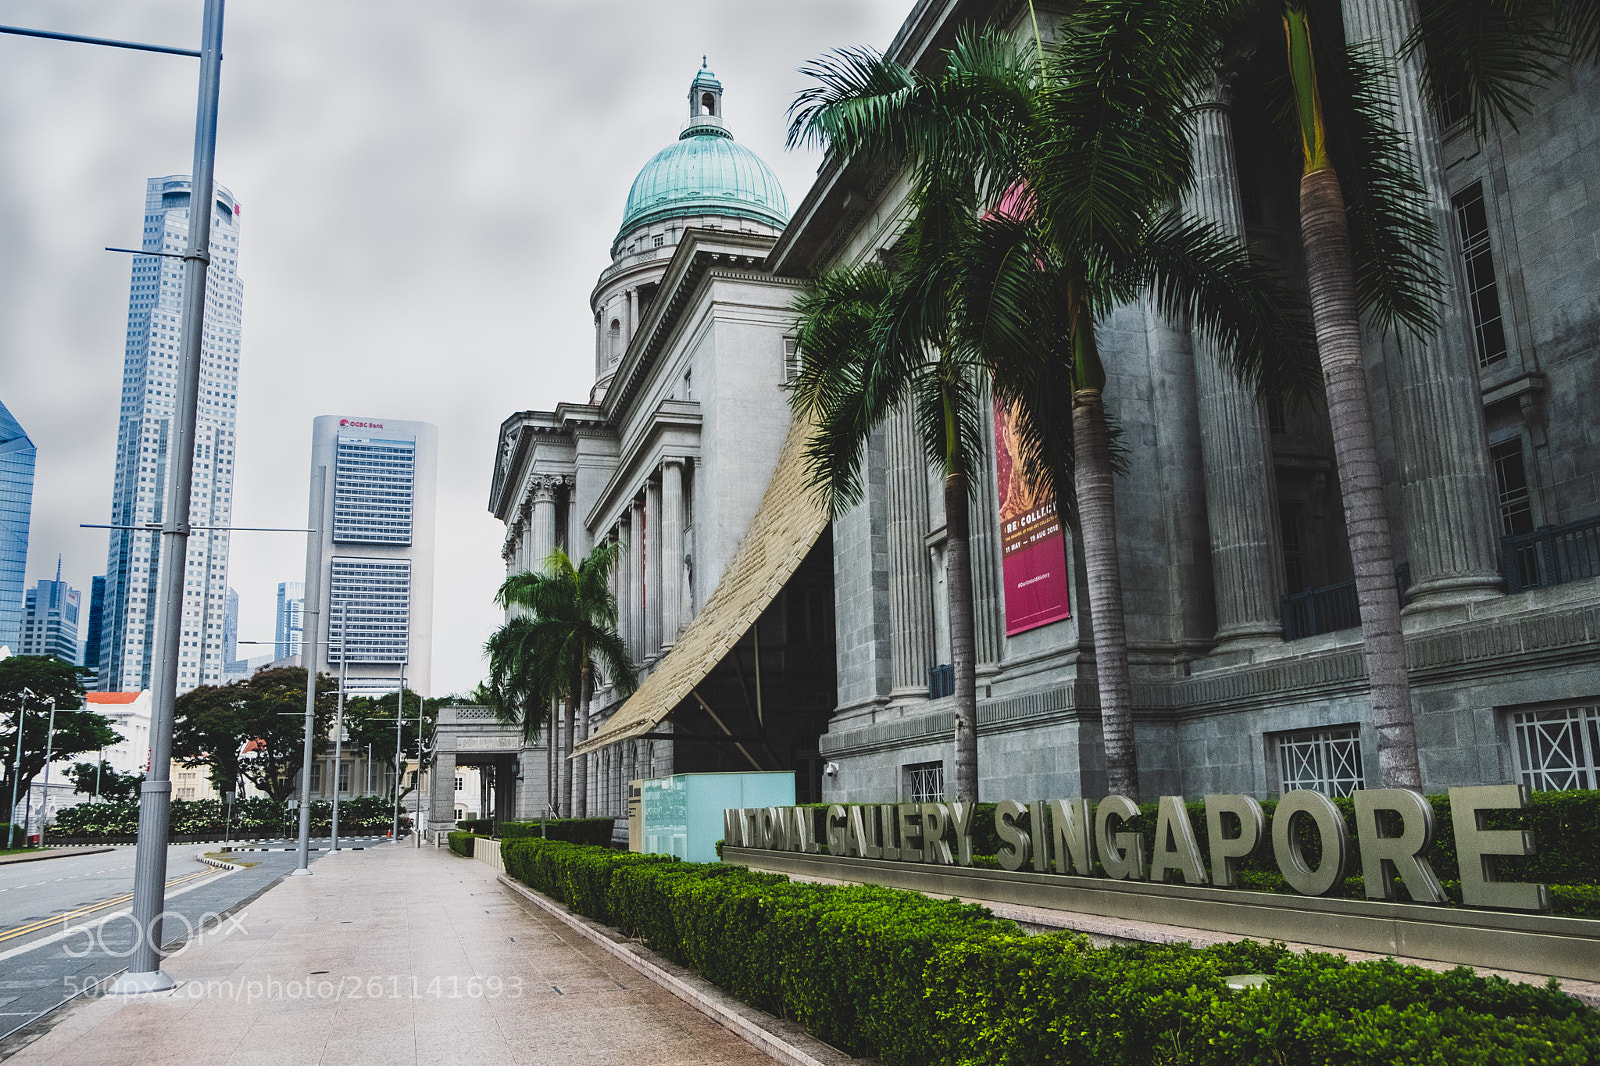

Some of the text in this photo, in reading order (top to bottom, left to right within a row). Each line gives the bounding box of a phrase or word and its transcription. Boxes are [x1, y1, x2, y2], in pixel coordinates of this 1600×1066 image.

[1011, 541, 1021, 551] MAY
[1036, 530, 1047, 539] AUG
[1047, 524, 1059, 535] 2018
[723, 784, 1549, 910] NATIONAL GALLERY SINGAPORE
